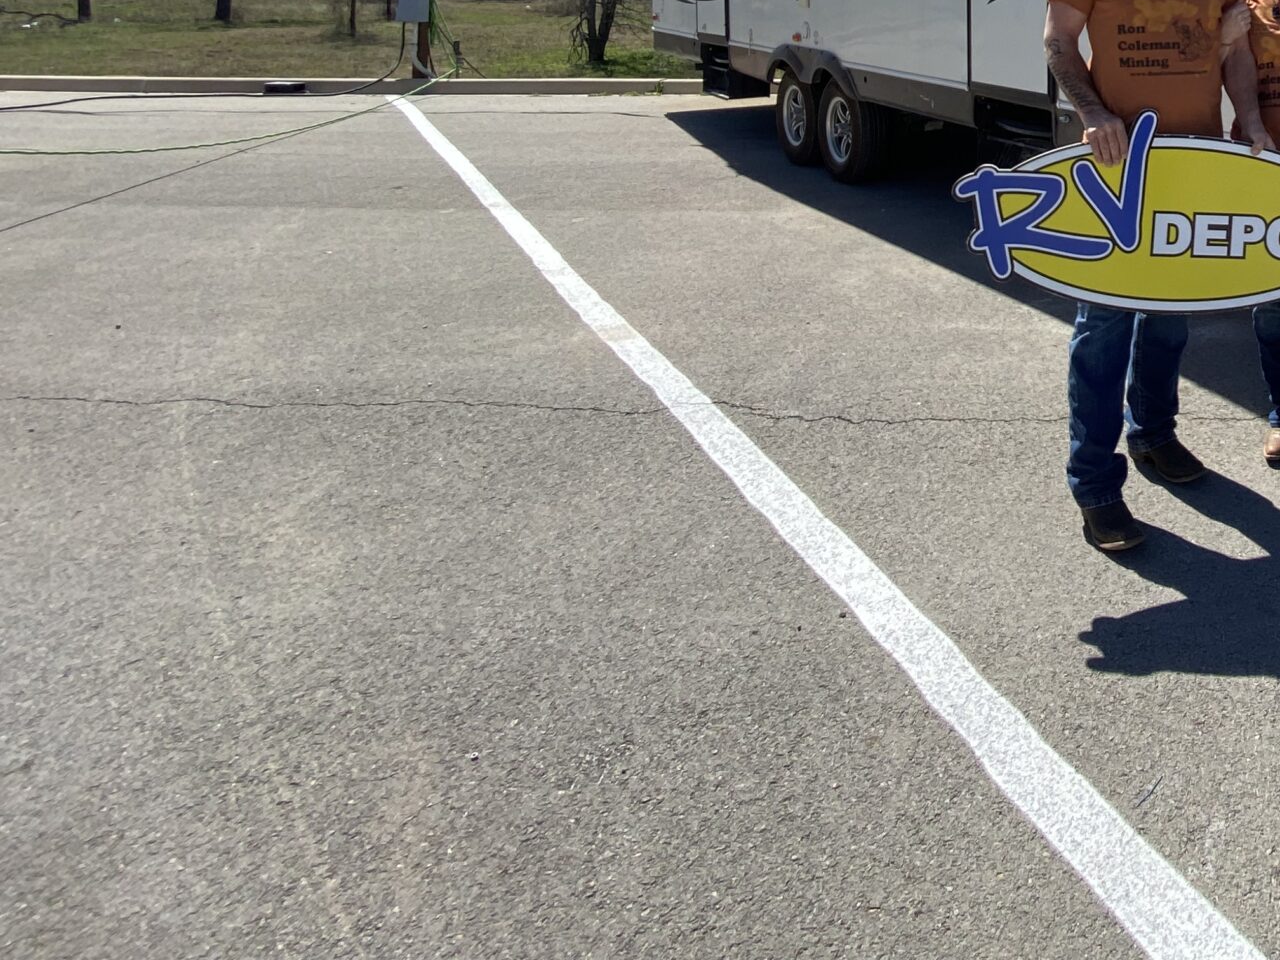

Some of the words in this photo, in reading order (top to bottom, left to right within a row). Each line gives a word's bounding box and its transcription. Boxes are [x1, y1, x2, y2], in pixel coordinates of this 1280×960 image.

[1117, 24, 1145, 35] Ron
[1117, 40, 1181, 51] Coleman
[1119, 56, 1169, 69] Mining
[1257, 61, 1274, 70] on
[954, 110, 1158, 279] RV
